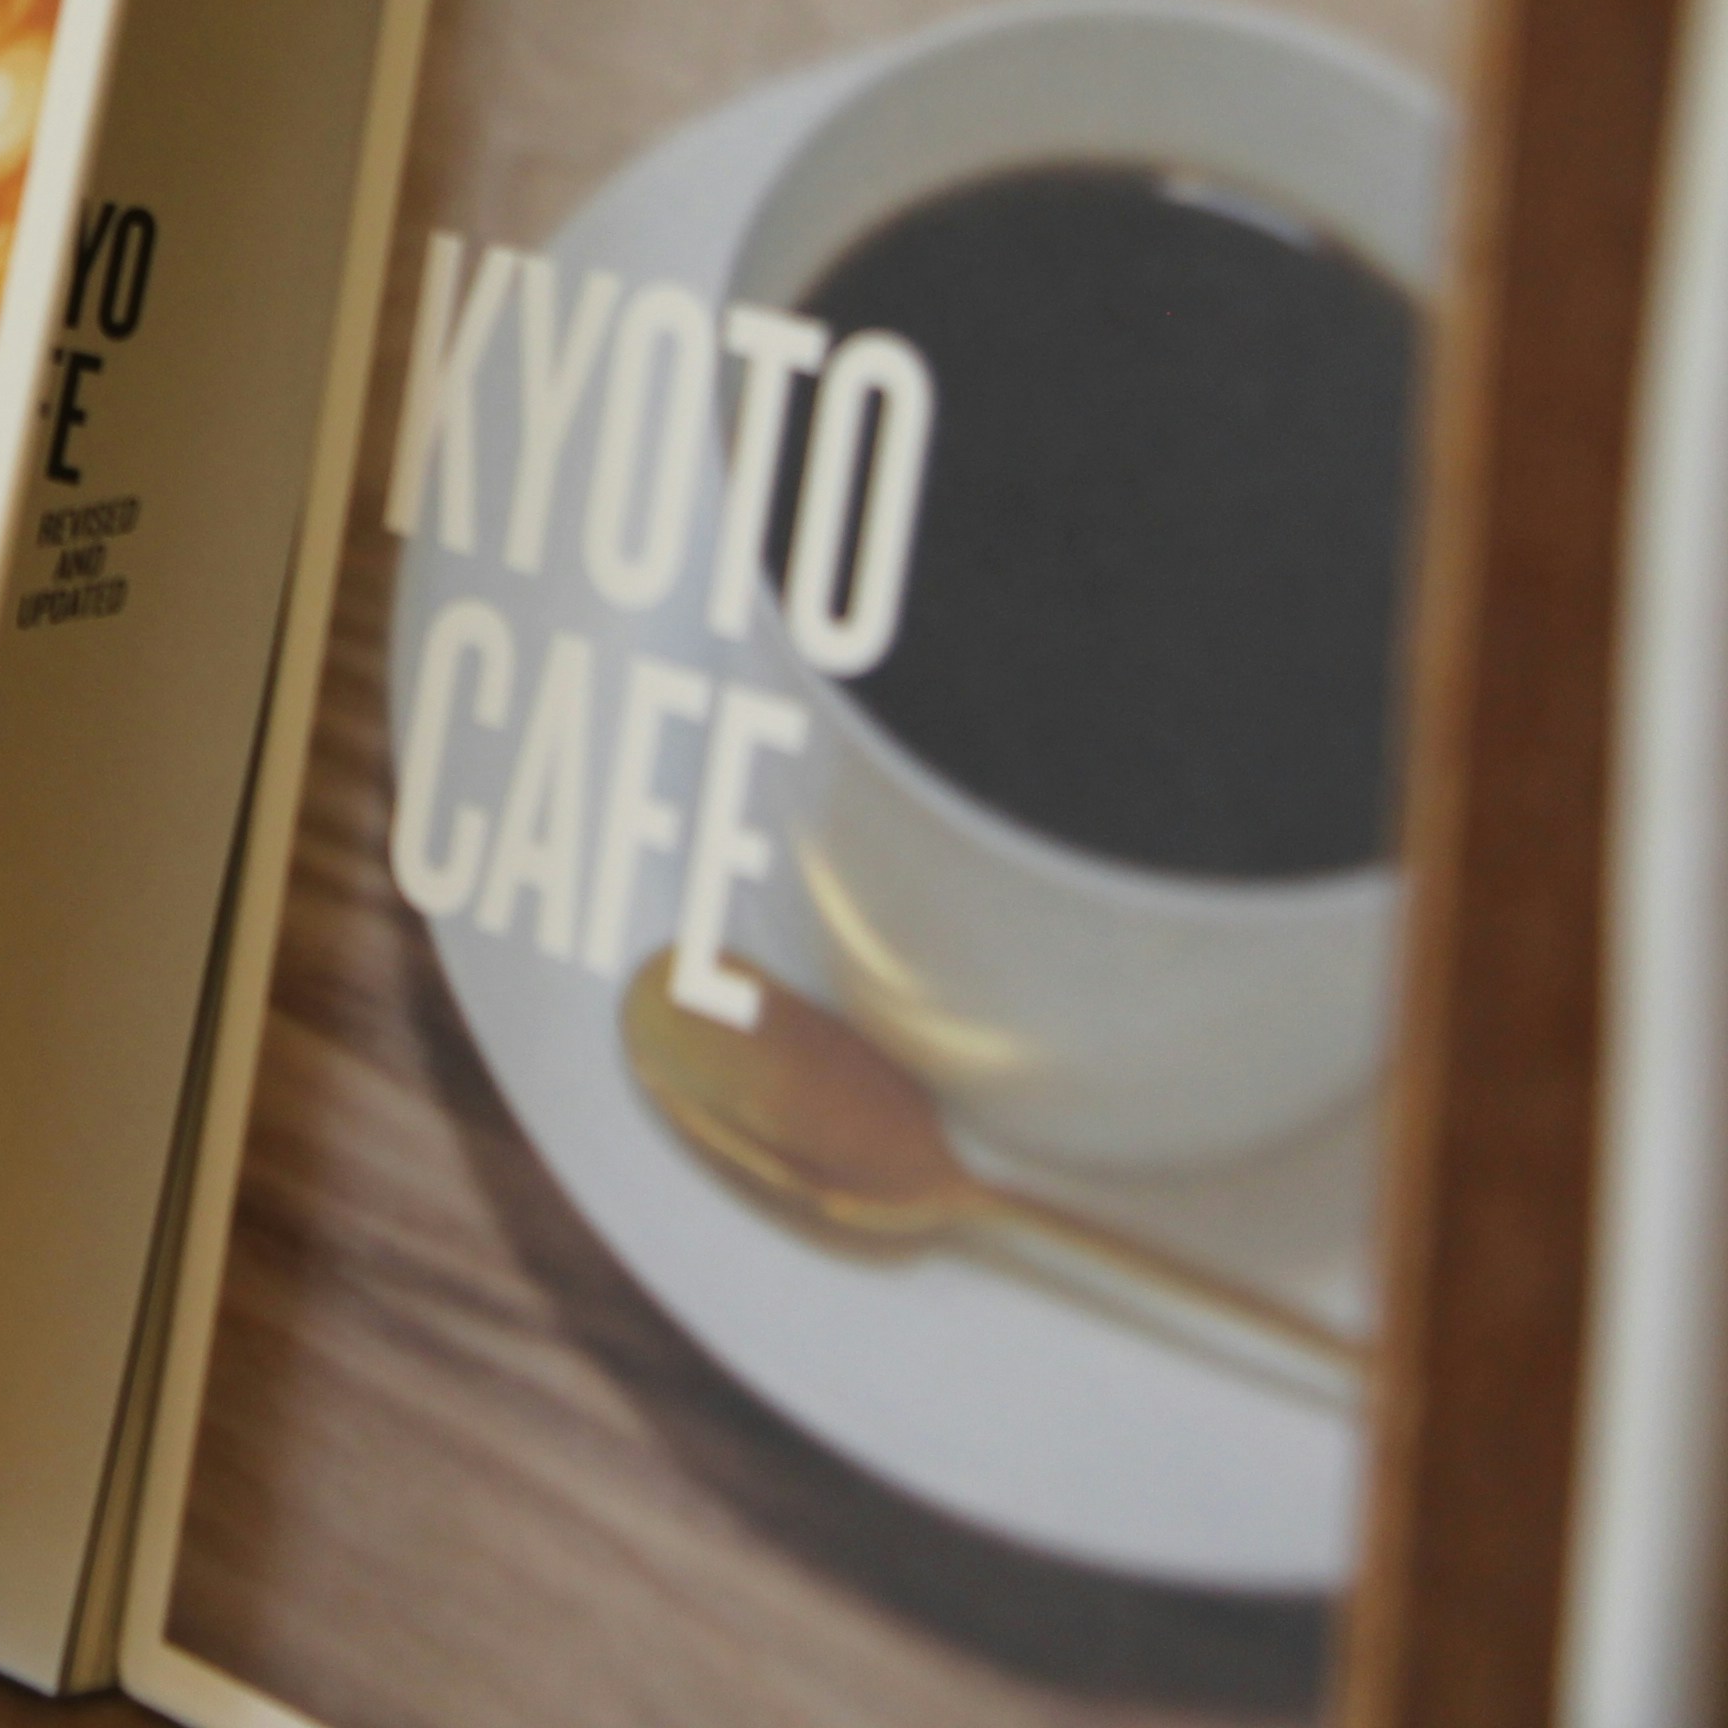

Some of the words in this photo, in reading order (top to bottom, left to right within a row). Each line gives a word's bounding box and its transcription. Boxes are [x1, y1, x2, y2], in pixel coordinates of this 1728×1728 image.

[381, 227, 938, 680] KYOTO
[36, 493, 143, 551] REVISED
[53, 542, 109, 583] AND
[16, 576, 130, 631] UPDATED
[390, 595, 812, 1032] CAFE
